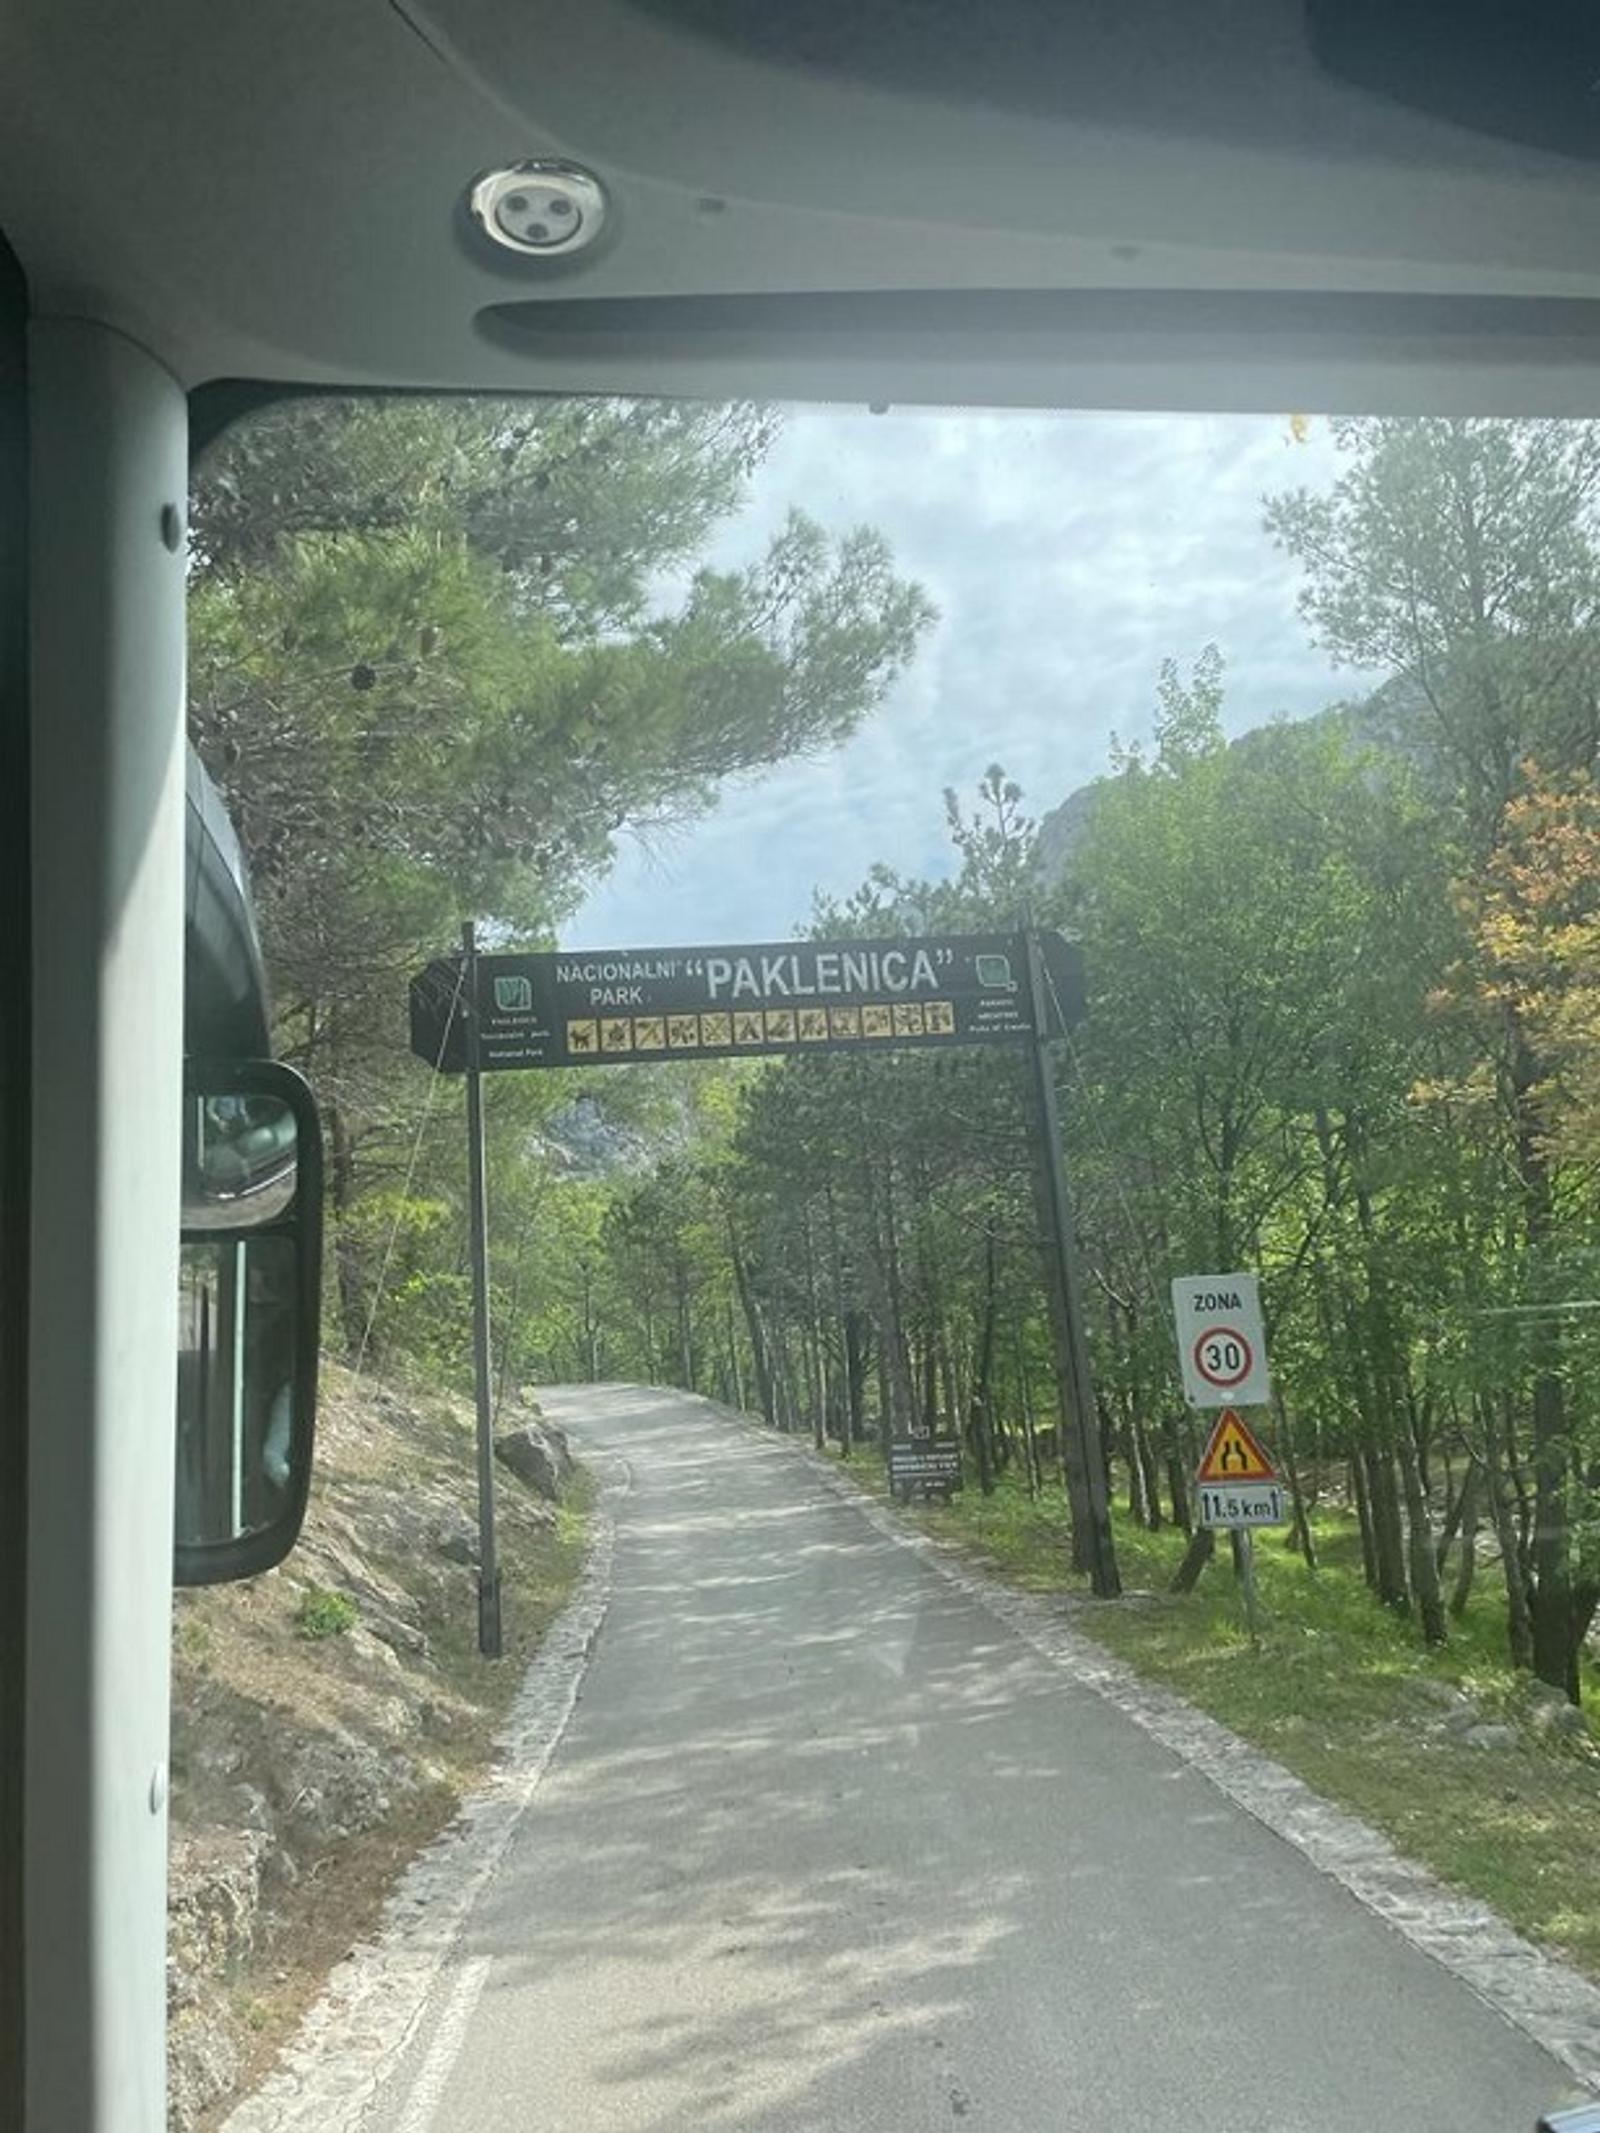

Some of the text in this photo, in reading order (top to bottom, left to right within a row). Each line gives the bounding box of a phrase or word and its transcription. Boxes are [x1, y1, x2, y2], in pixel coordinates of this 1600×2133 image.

[556, 960, 675, 983] NACIONALNI
[590, 986, 643, 1006] PARK
[1193, 1292, 1243, 1312] ZONA
[1205, 1342, 1241, 1372] 30
